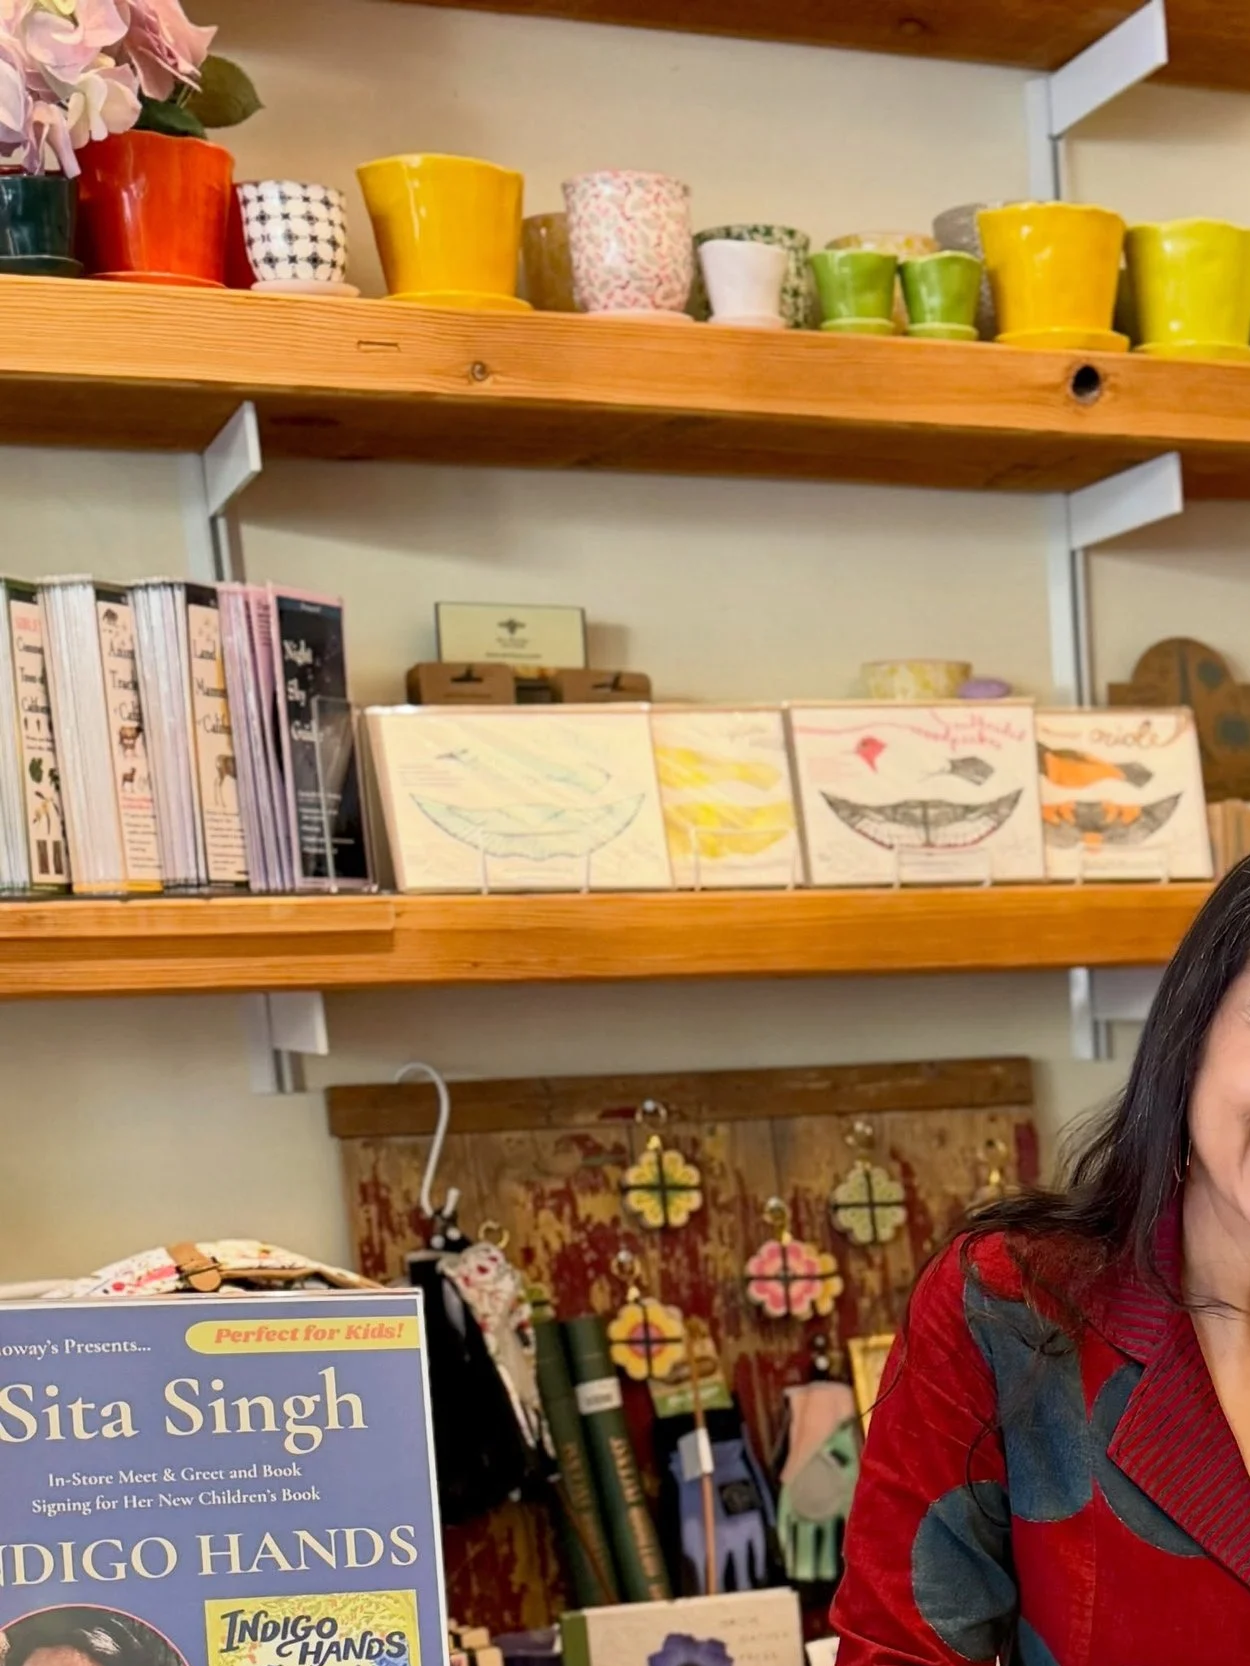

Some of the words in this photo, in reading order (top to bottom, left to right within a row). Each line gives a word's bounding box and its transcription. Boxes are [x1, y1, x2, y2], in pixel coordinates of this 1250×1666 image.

[214, 1326, 299, 1344] Perfect
[304, 1325, 341, 1340] for
[345, 1322, 405, 1340] Kids!
[0, 1340, 59, 1360] oway's
[64, 1339, 151, 1354] Presents...
[0, 1384, 139, 1443] Sita
[164, 1366, 368, 1455] Singh
[48, 1472, 114, 1488] In-Store
[118, 1470, 158, 1485] Meet
[162, 1468, 176, 1483] &
[181, 1467, 224, 1482] Greet
[229, 1464, 257, 1479] and
[262, 1462, 302, 1478] Book
[31, 1498, 92, 1517] Signing
[95, 1495, 119, 1511] for
[124, 1494, 154, 1509] Her
[158, 1492, 194, 1507] New
[198, 1489, 277, 1506] Children's
[281, 1487, 321, 1502] Book
[195, 1523, 418, 1577] HANDS
[219, 1609, 338, 1658] INDIGO
